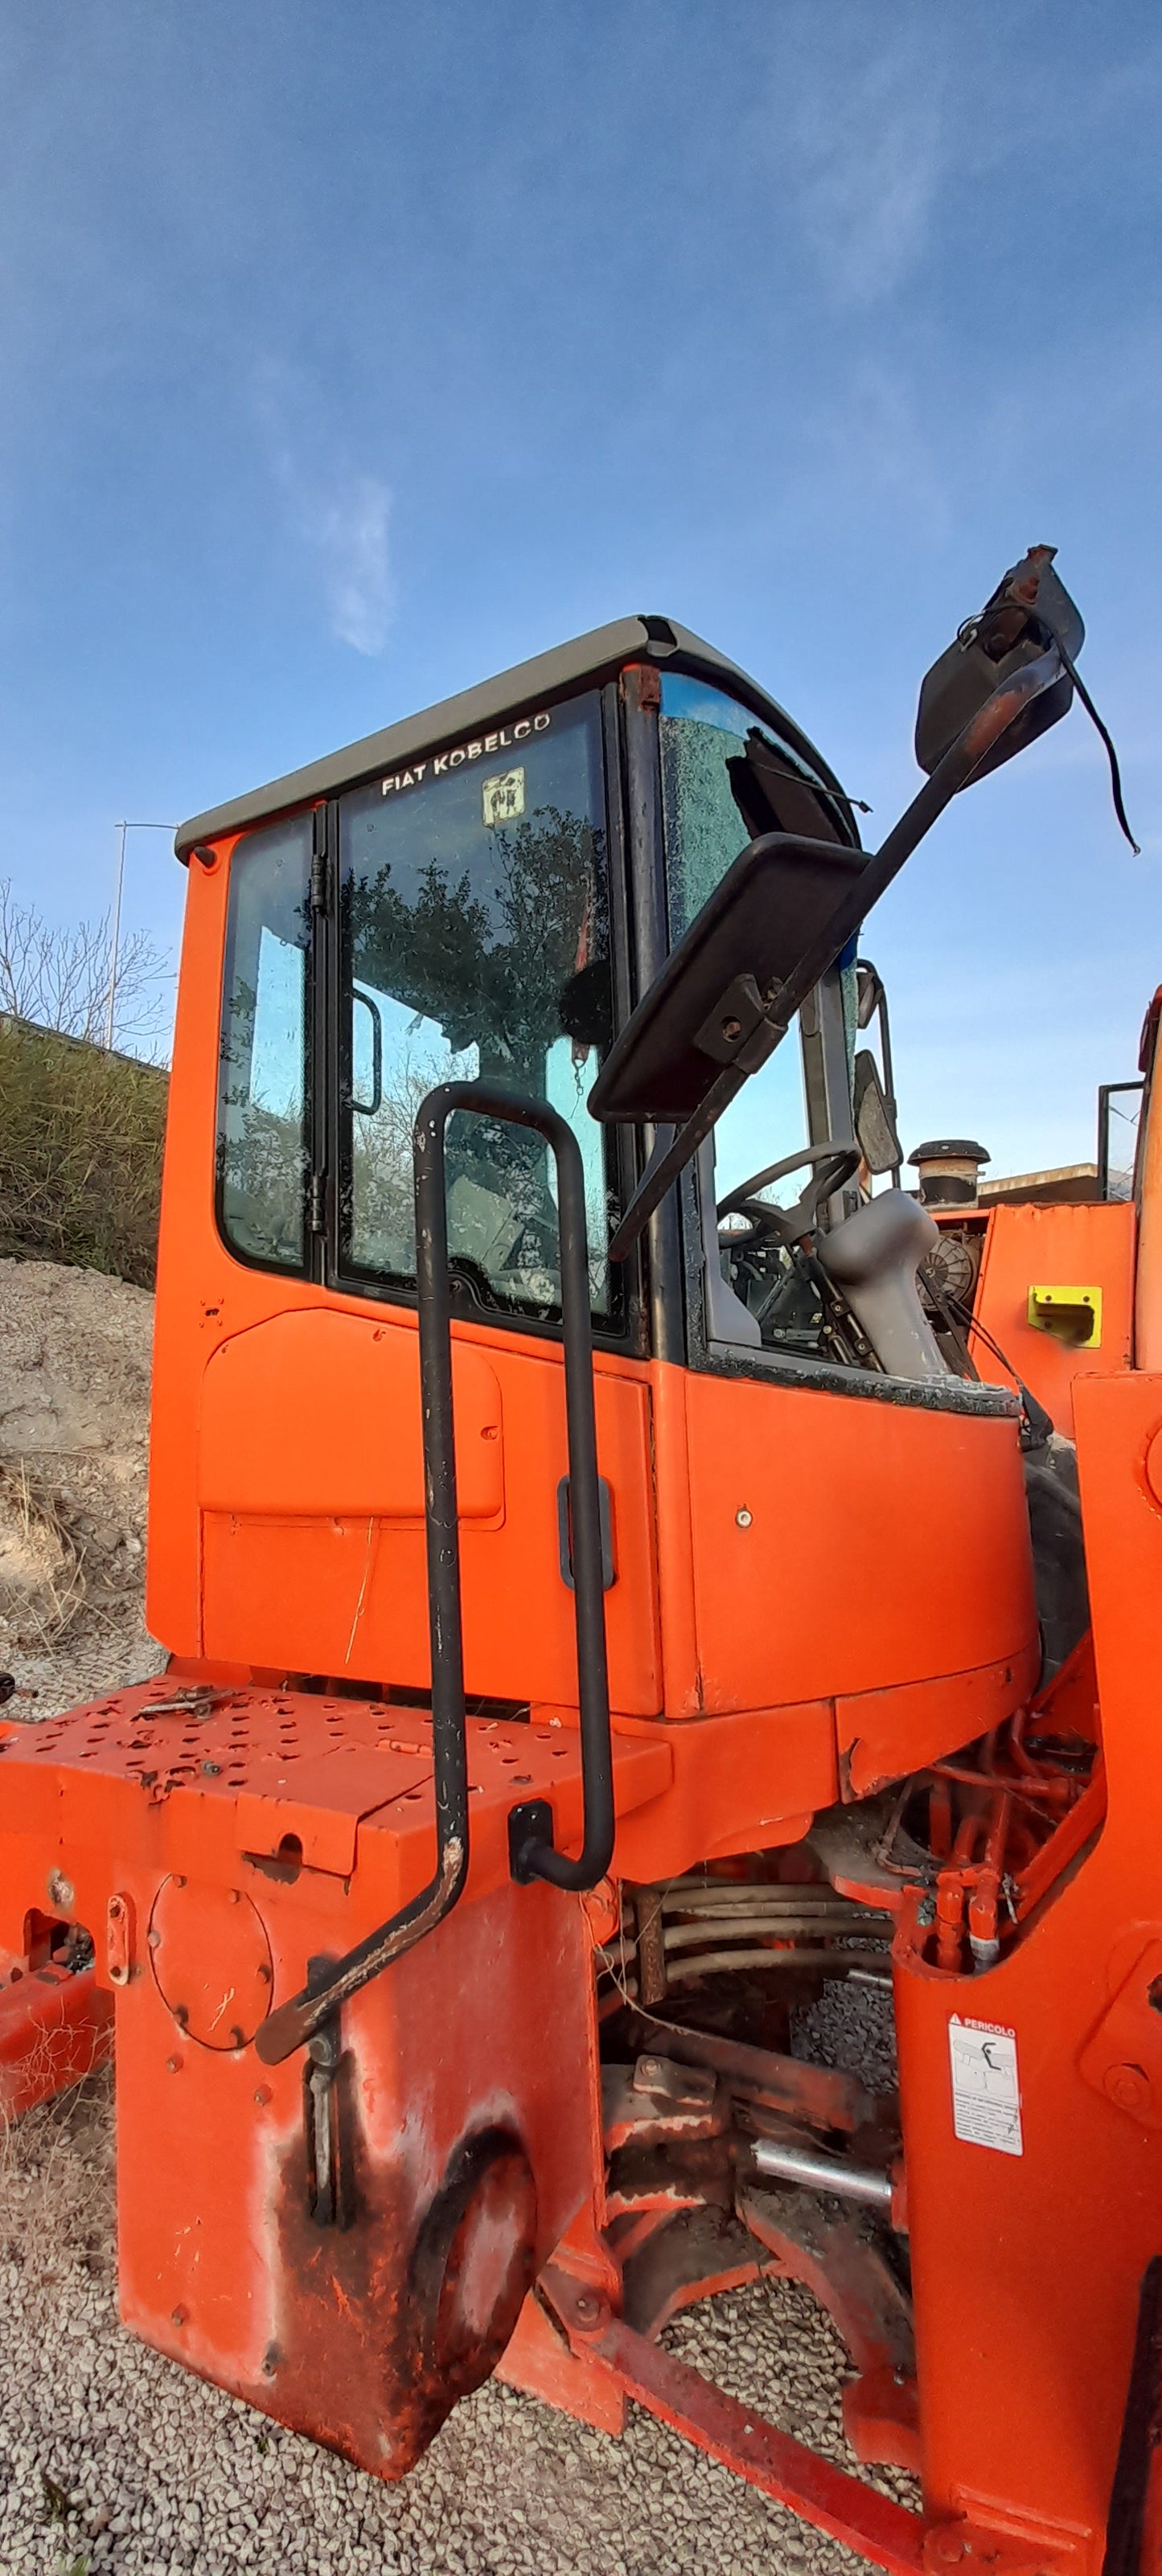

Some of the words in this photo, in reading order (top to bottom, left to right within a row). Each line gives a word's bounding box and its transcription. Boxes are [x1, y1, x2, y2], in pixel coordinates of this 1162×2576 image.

[381, 765, 427, 796] FIAT
[434, 712, 551, 776] KOBELCO
[964, 2017, 1016, 2038] PERICOLO
